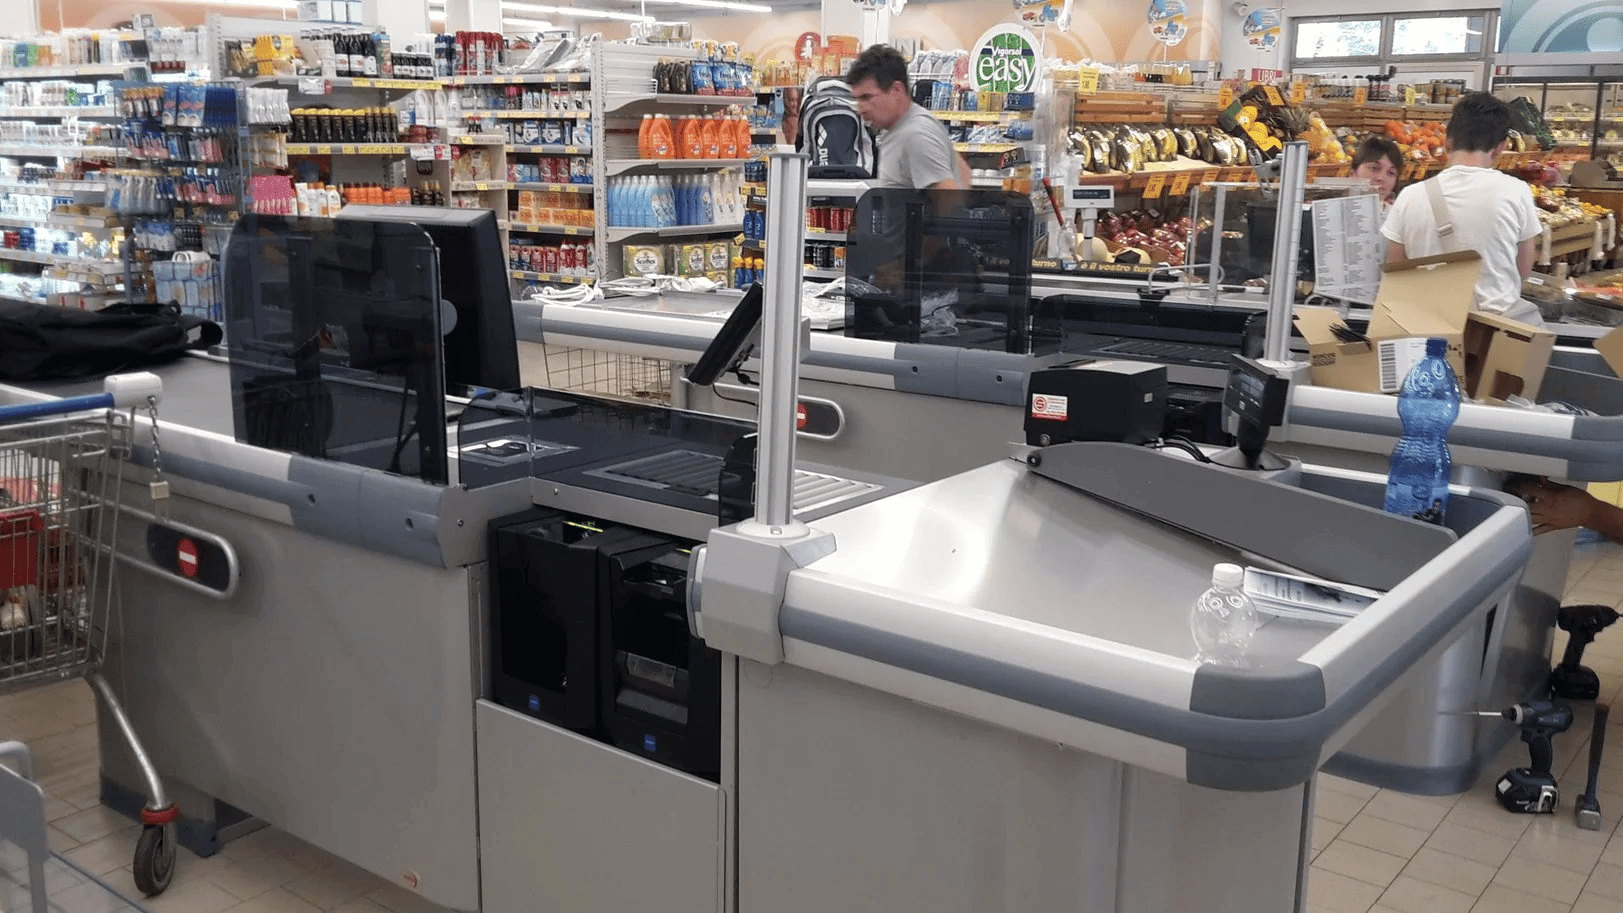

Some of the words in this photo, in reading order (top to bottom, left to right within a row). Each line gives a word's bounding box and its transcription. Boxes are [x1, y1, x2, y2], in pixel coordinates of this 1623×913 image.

[991, 46, 1022, 57] Vigorsol
[979, 57, 1036, 91] easy
[1090, 262, 1097, 270] il
[1100, 264, 1131, 272] vostro
[1133, 265, 1157, 273] turn
